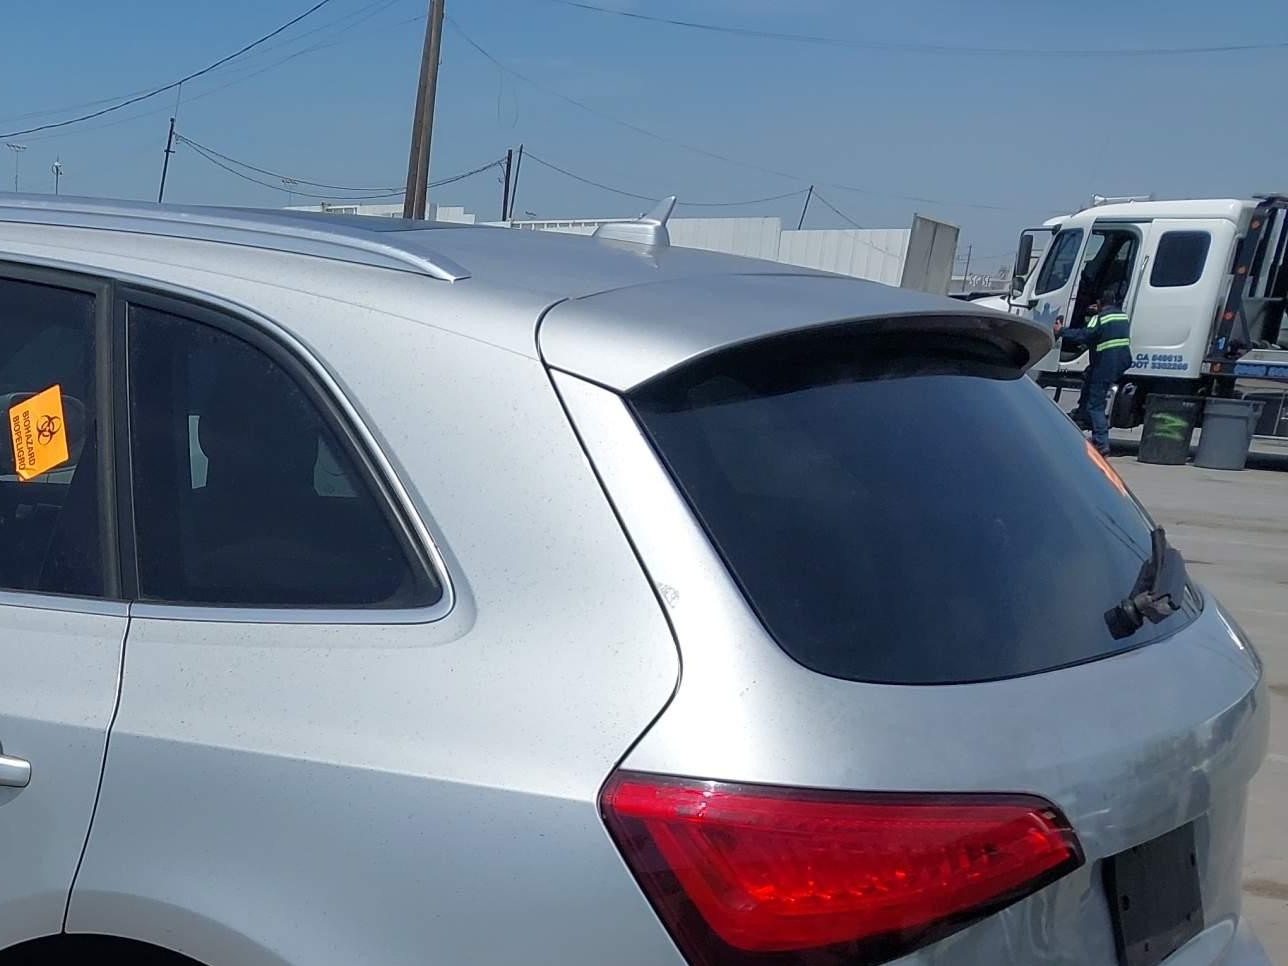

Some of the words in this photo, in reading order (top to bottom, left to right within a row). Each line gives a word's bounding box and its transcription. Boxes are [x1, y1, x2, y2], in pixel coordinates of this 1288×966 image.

[1136, 353, 1149, 361] CA
[13, 415, 26, 471] BIOPELIGRO
[22, 409, 36, 466] BIOHAZARD
